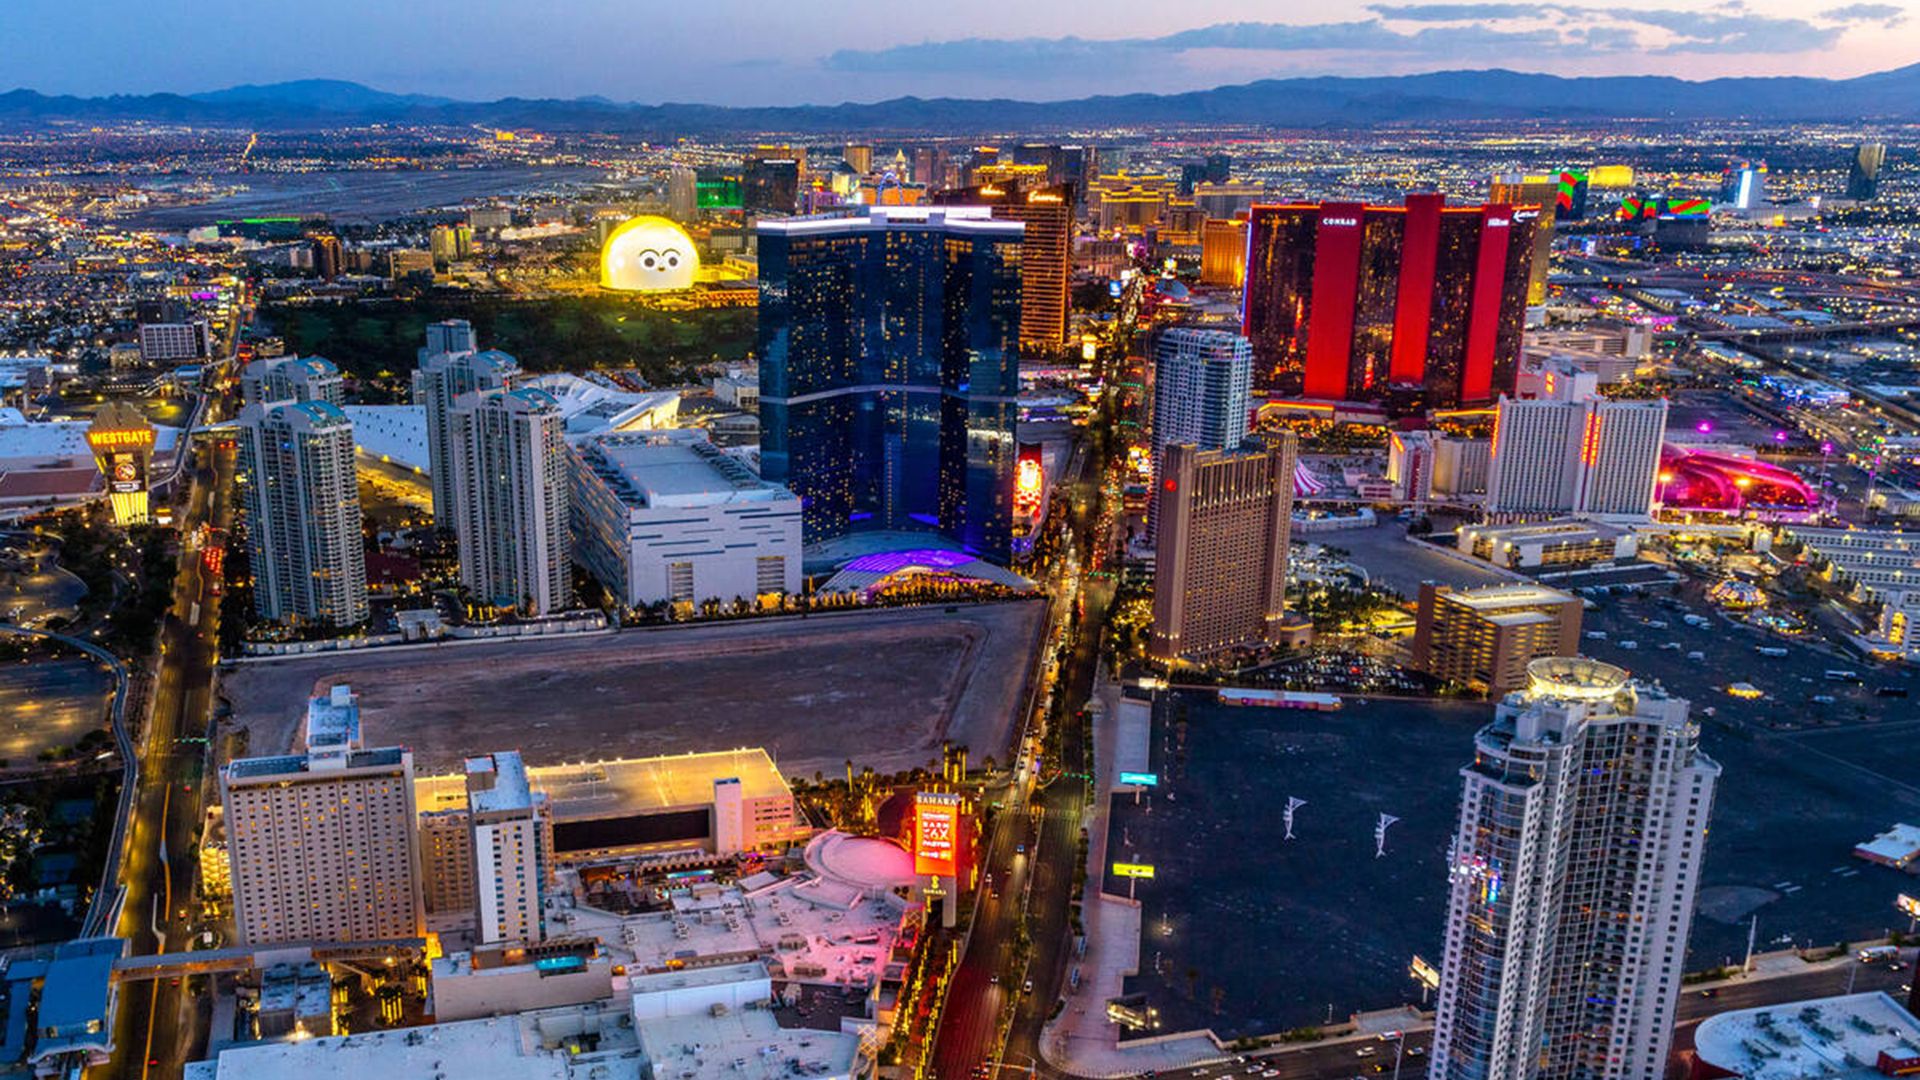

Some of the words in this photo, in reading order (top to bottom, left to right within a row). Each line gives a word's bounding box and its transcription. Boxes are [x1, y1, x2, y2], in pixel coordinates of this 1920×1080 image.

[1322, 218, 1357, 226] CONRAD
[89, 430, 152, 445] WESTGATE
[916, 795, 956, 806] SAHARA
[930, 829, 949, 841] 6X
